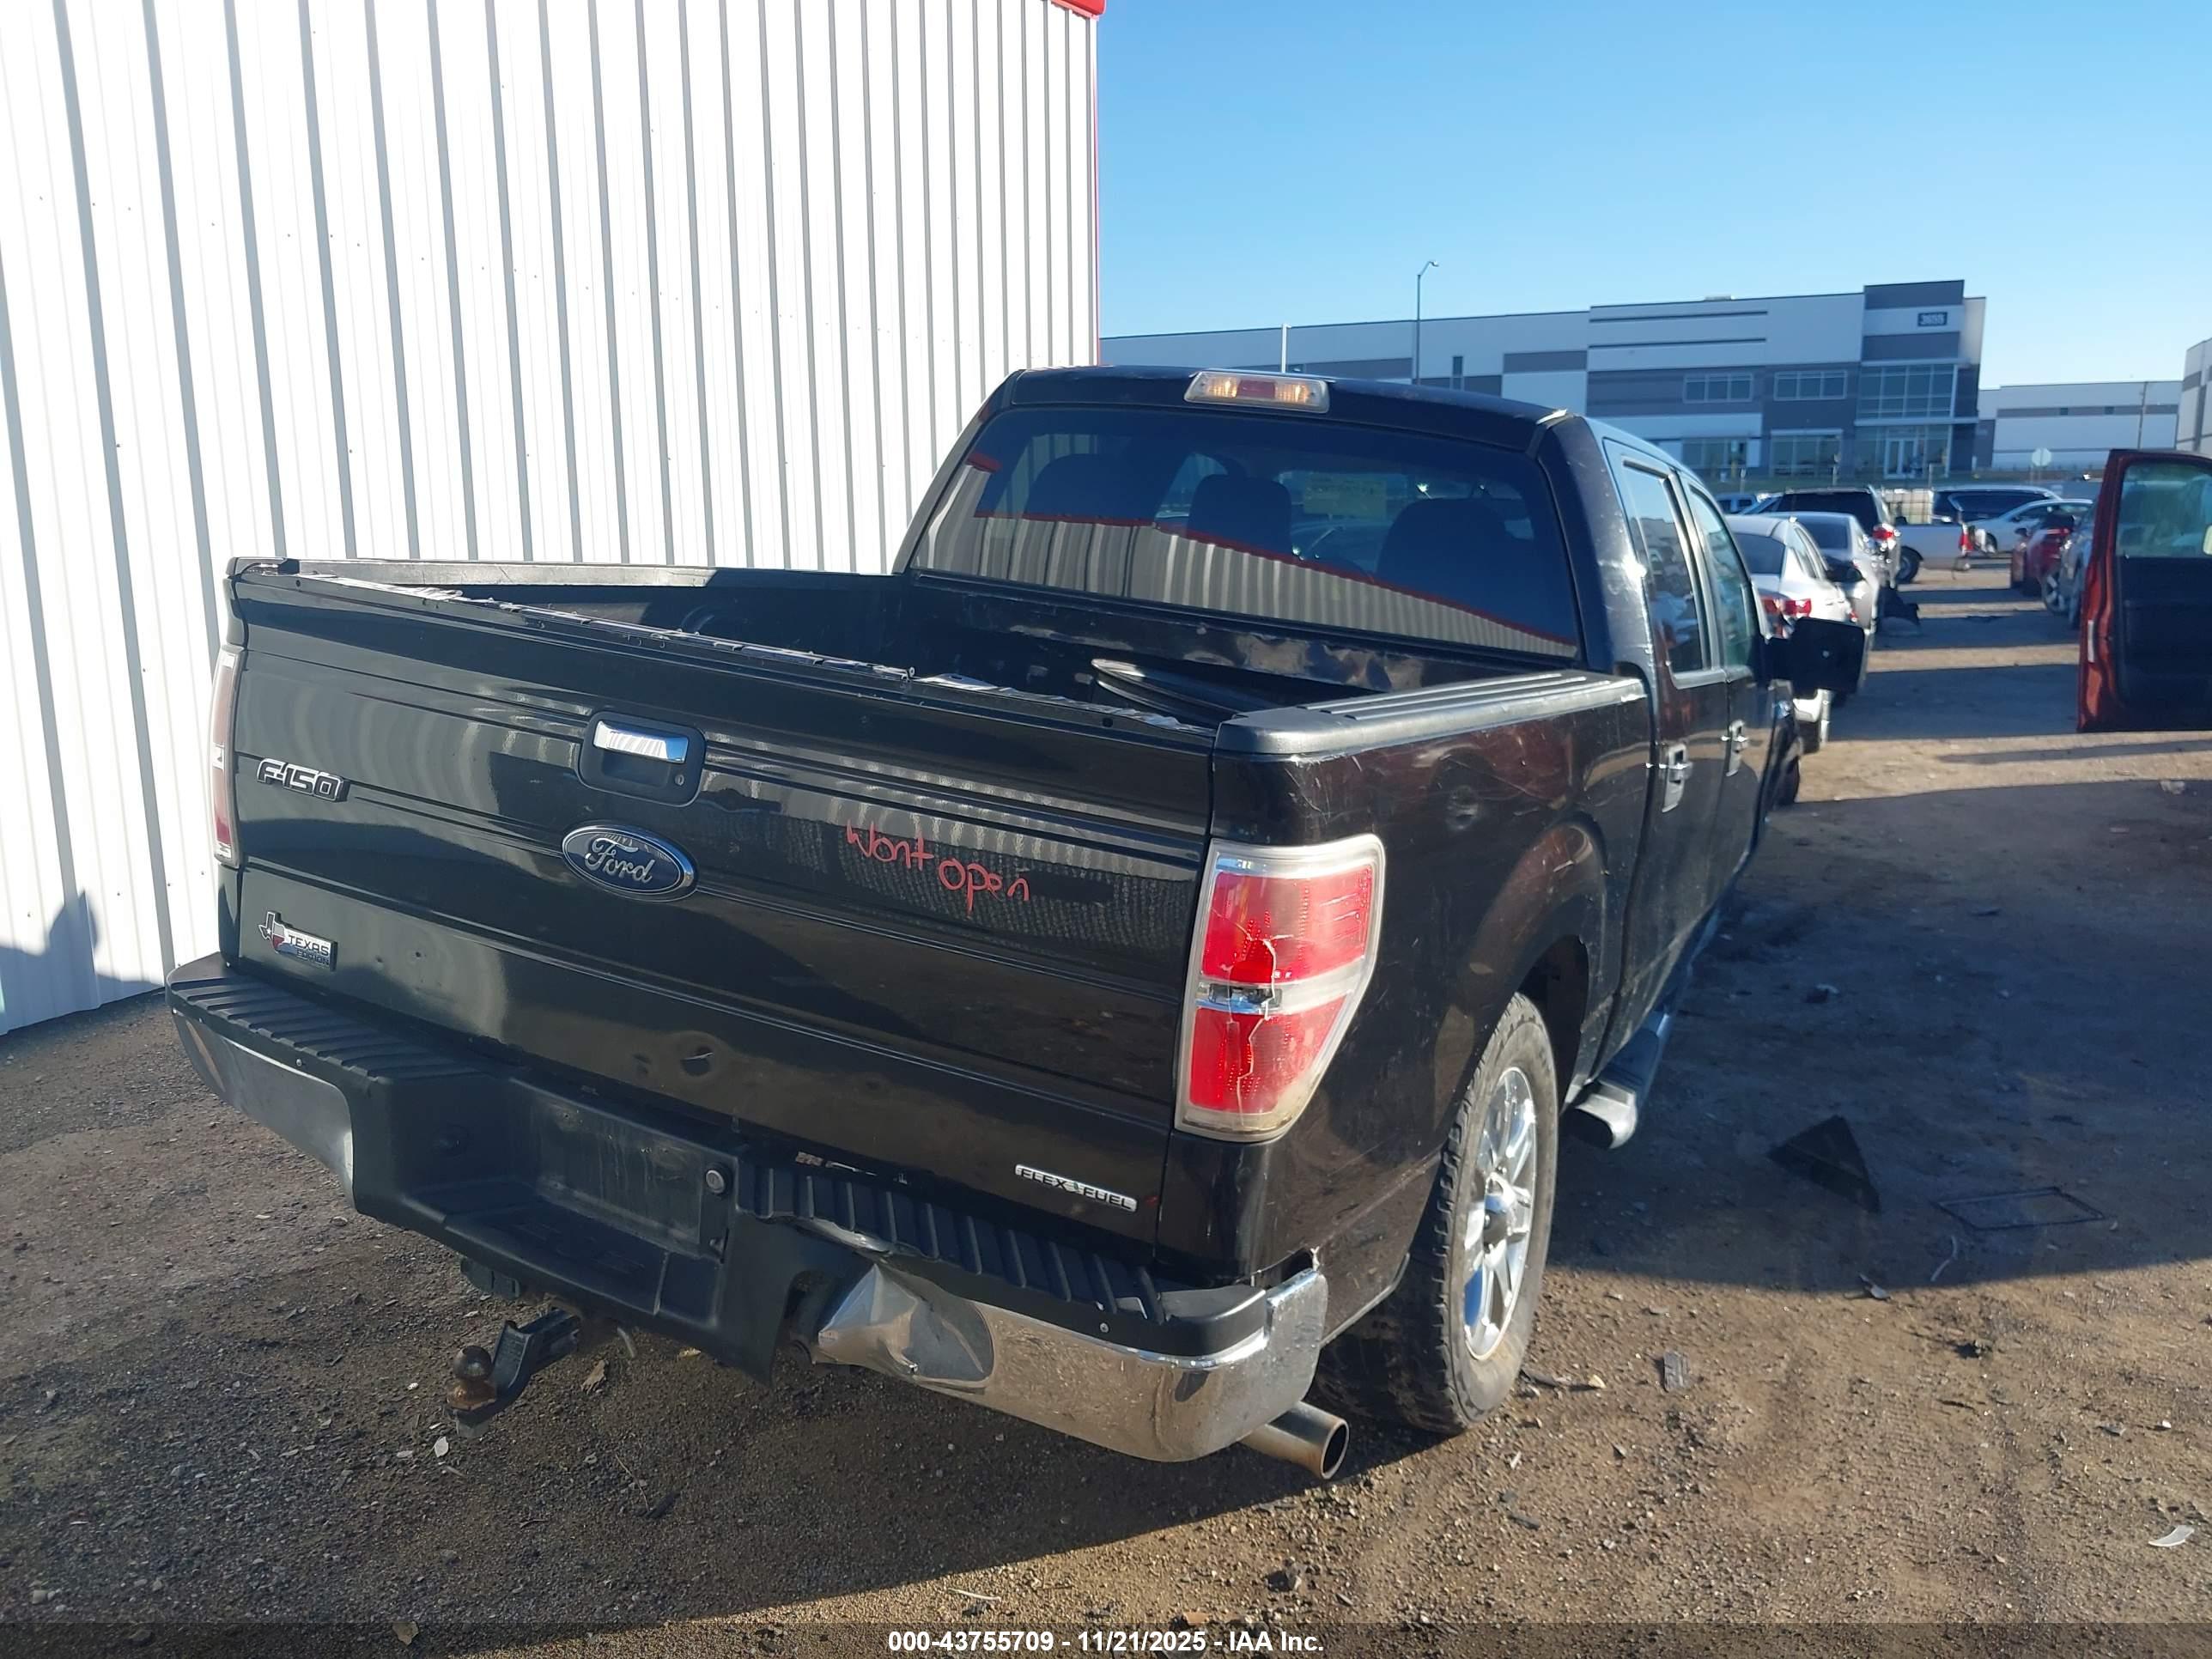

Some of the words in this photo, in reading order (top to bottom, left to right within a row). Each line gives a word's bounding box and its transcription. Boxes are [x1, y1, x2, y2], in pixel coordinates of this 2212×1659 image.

[258, 758, 343, 800] F-150
[584, 837, 655, 884] Ford
[289, 934, 330, 957] TEXAS
[296, 949, 330, 965] EDITION
[1019, 1166, 1068, 1192] FLEX
[1082, 1185, 1134, 1211] FUEL
